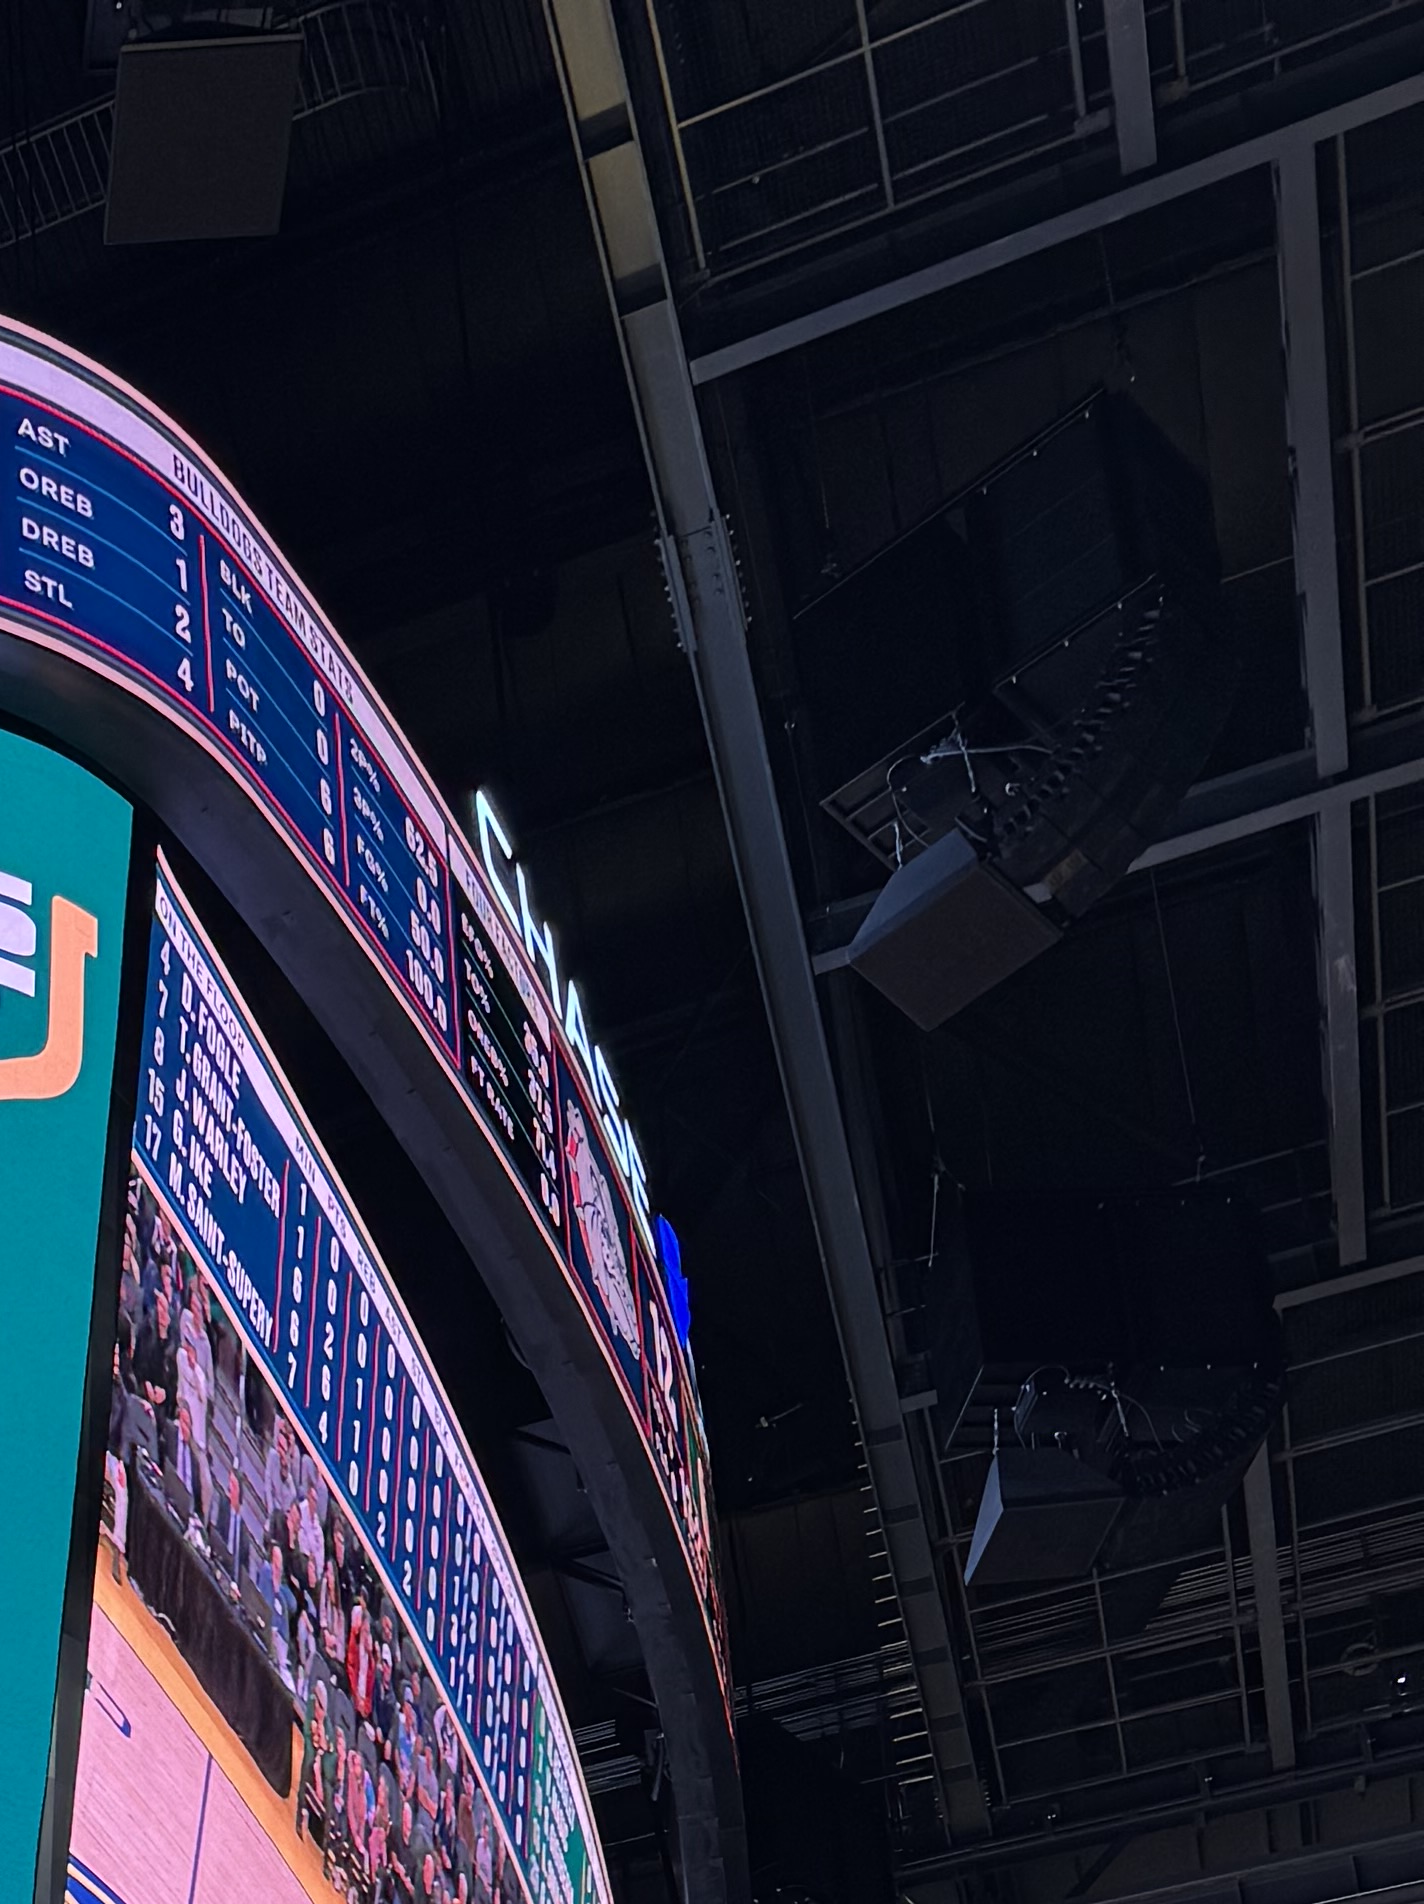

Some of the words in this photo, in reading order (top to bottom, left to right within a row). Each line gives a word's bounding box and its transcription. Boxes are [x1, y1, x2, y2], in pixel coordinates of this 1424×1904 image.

[17, 417, 70, 457] AST
[19, 467, 94, 519] OREB
[21, 517, 96, 569] DREB
[24, 569, 74, 610] STL
